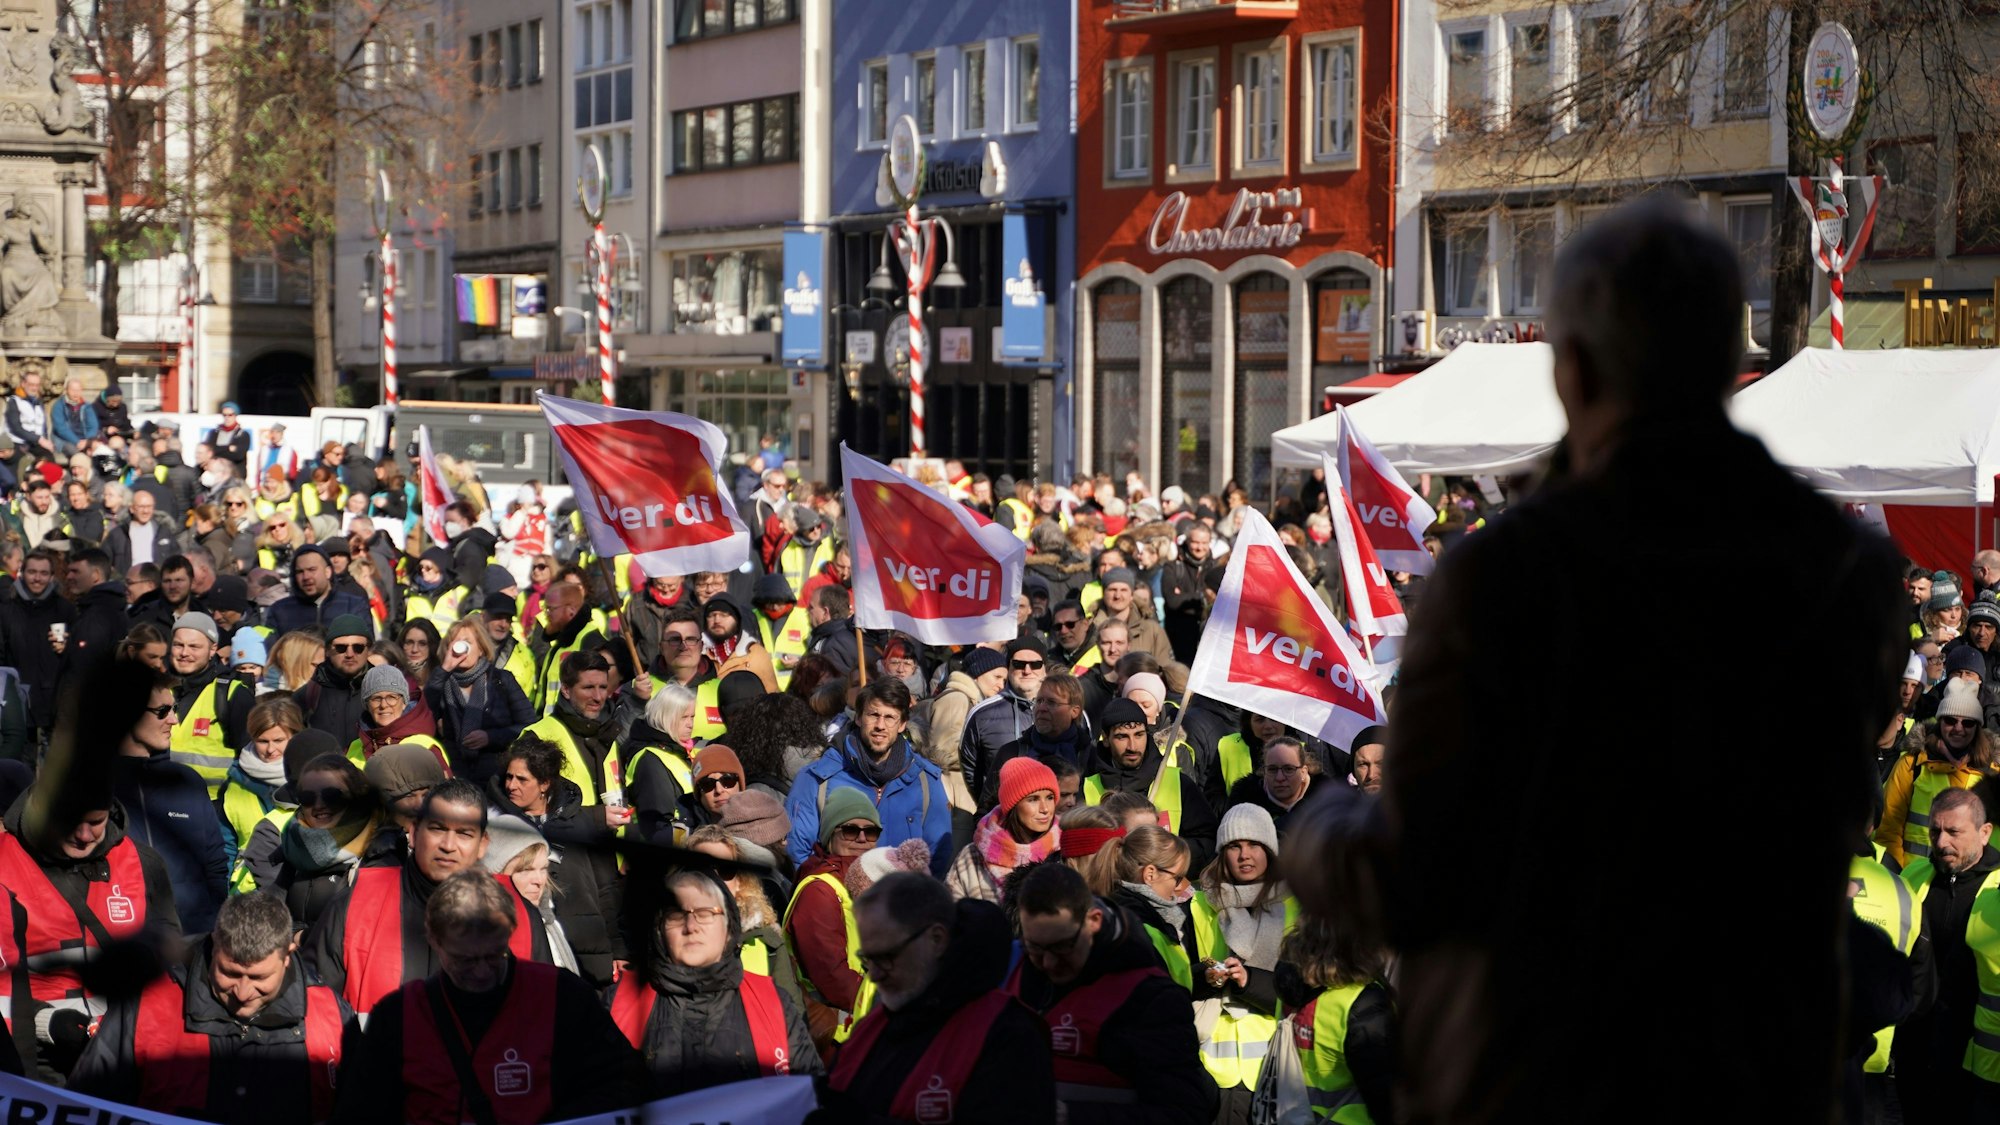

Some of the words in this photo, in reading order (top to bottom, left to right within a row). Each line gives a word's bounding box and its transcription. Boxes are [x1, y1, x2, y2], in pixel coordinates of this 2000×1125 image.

[1146, 187, 1302, 255] Chocolaterie
[599, 494, 713, 530] ver.di
[883, 557, 990, 601] ver.di
